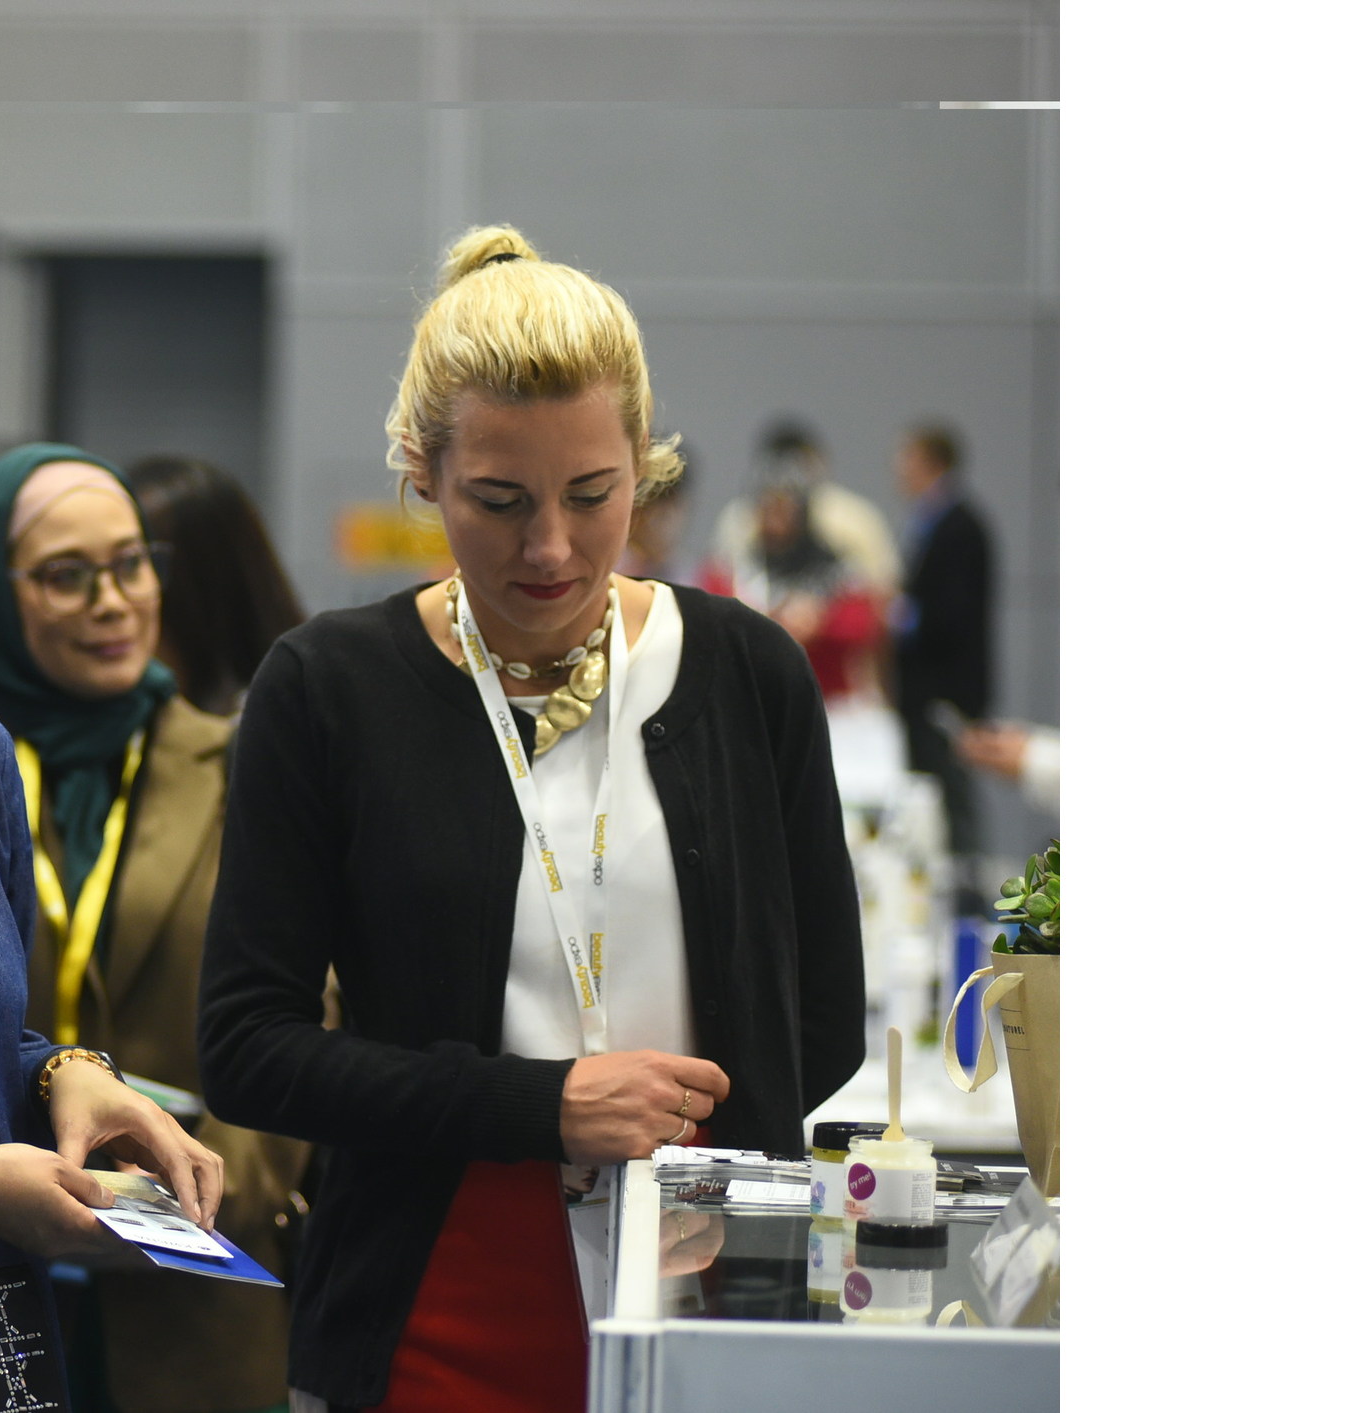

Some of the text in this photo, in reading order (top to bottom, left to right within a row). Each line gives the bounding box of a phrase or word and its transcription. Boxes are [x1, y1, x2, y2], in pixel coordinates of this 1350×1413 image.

[496, 710, 528, 779] beautyexpo
[533, 822, 563, 893] beautyexpo
[592, 813, 607, 886] beautyexpo
[568, 936, 596, 1009] beautyexpo
